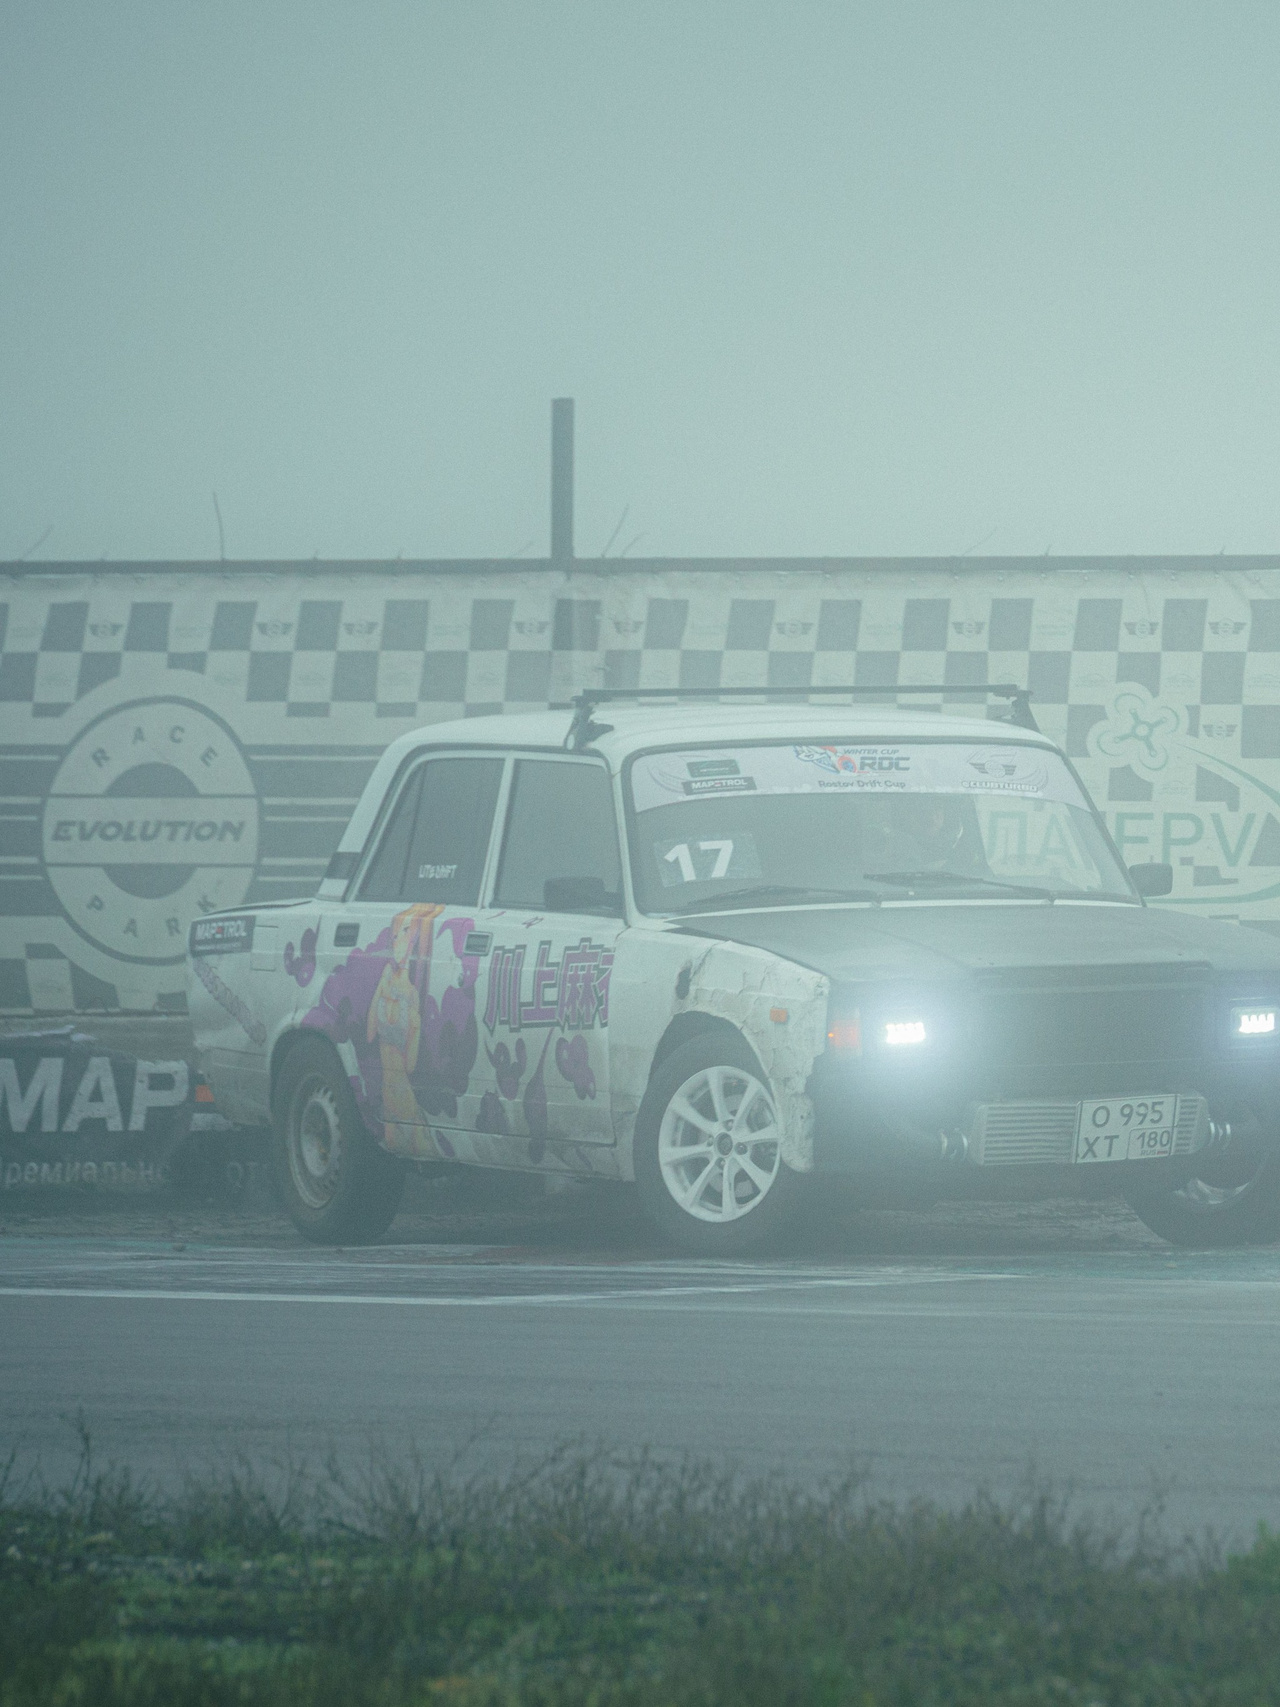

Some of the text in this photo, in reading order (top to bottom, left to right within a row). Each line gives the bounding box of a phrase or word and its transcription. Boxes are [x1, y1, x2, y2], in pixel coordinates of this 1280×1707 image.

[90, 724, 220, 769] RACE
[860, 756, 911, 771] RDC
[691, 778, 748, 789] MAPETROL
[818, 779, 906, 789] Rostov Drift Cup
[51, 820, 246, 842] EVOLUTION
[1116, 812, 1256, 867] FPV
[664, 840, 734, 882] 17
[86, 893, 217, 937] PARK
[195, 920, 248, 941] MAPETROL
[0, 1057, 232, 1133] MAP
[1119, 1101, 1164, 1127] 995
[1136, 1130, 1171, 1149] 180
[1140, 1149, 1157, 1157] RUS
